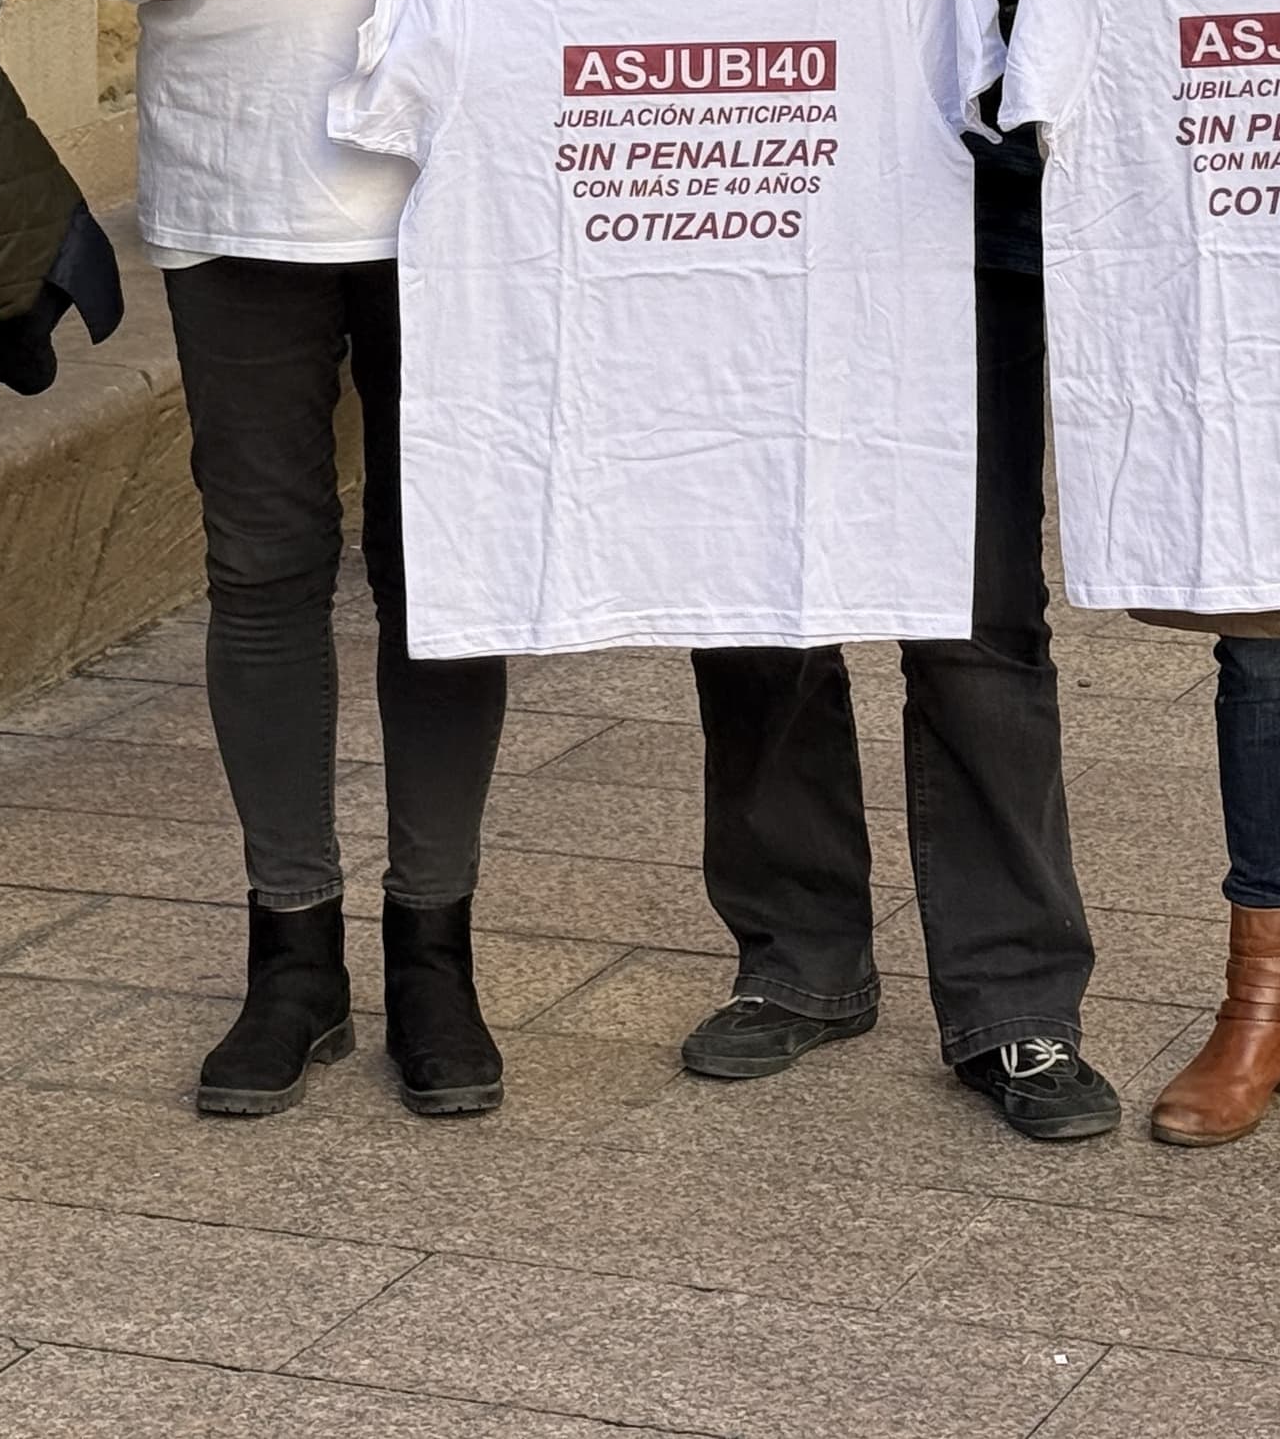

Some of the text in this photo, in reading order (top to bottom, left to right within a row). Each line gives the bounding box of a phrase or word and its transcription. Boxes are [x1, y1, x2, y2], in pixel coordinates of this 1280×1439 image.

[574, 46, 826, 91] ASJUBI40
[554, 104, 838, 128] JUBILACIÓN ANTICIPADA
[1176, 115, 1235, 146] SIN
[555, 138, 838, 172] SIN PENALIZAR
[1193, 152, 1243, 172] CON
[573, 172, 821, 198] CON MÁS DE 40 AÑOS
[585, 210, 802, 242] COTIZADOS
